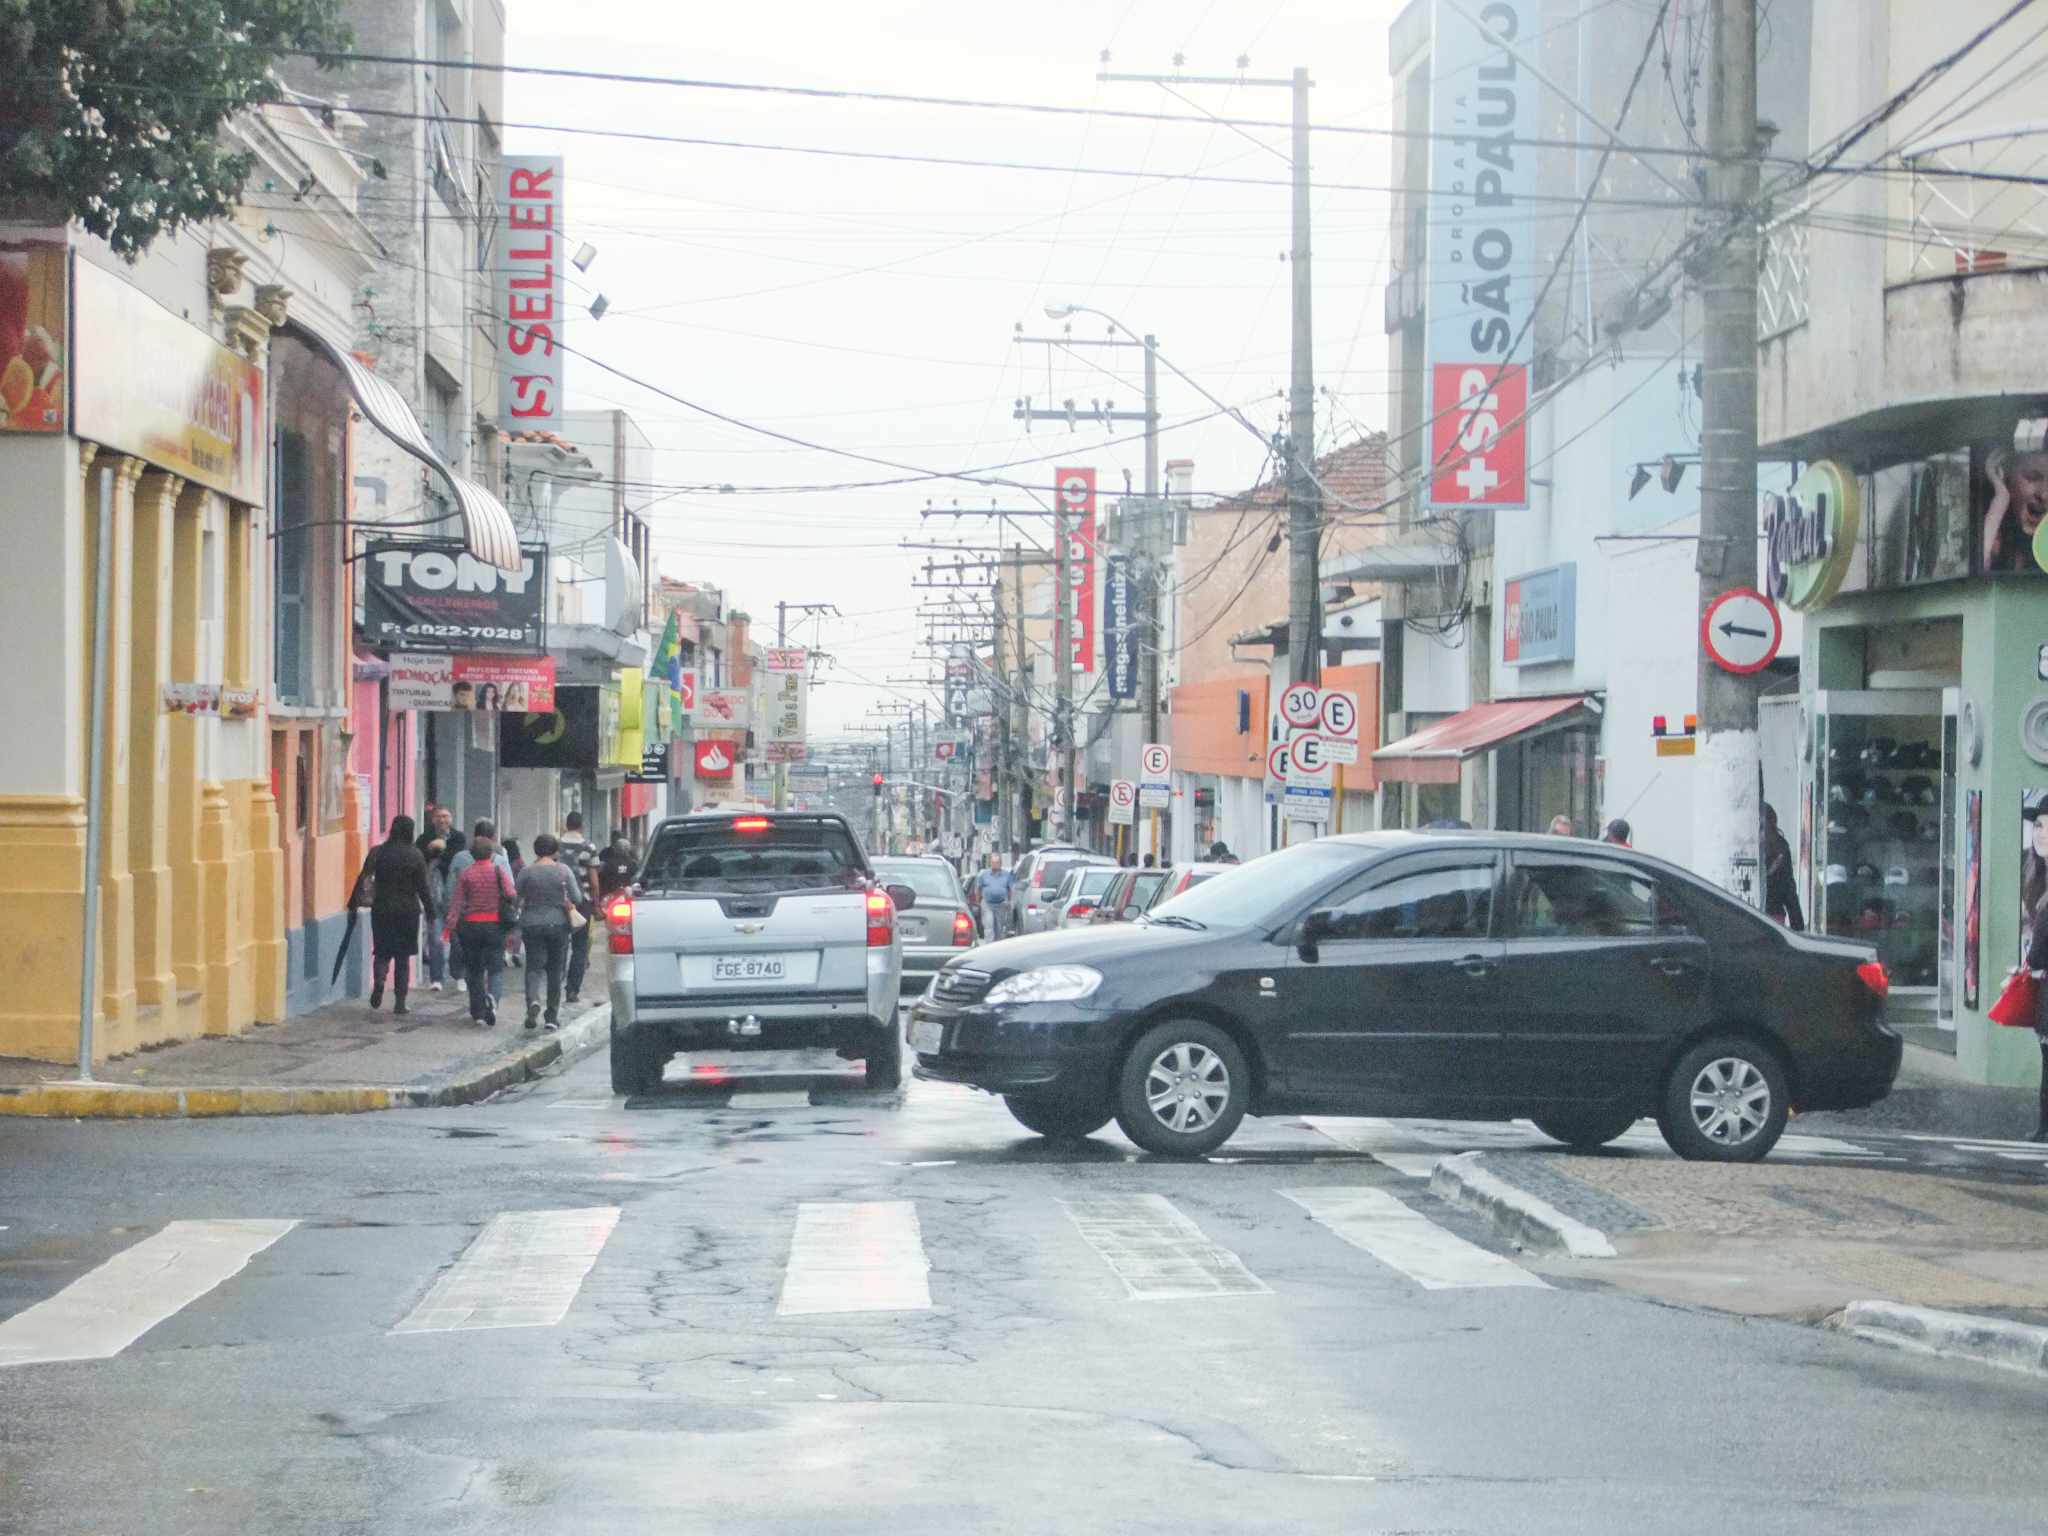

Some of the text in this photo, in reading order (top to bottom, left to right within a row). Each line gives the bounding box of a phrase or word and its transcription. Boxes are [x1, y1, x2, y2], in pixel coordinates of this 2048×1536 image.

[1461, 2, 1518, 354] SÃO PAULO
[508, 167, 554, 357] SELLER
[375, 551, 534, 594] TONY
[382, 622, 522, 640] F: 4022-7028
[1112, 558, 1131, 693] magazineluiza
[391, 669, 454, 686] PROMOÇÃO
[1289, 691, 1316, 713] 30
[1332, 702, 1344, 726] E
[1152, 752, 1161, 768] E
[1304, 742, 1319, 764] E
